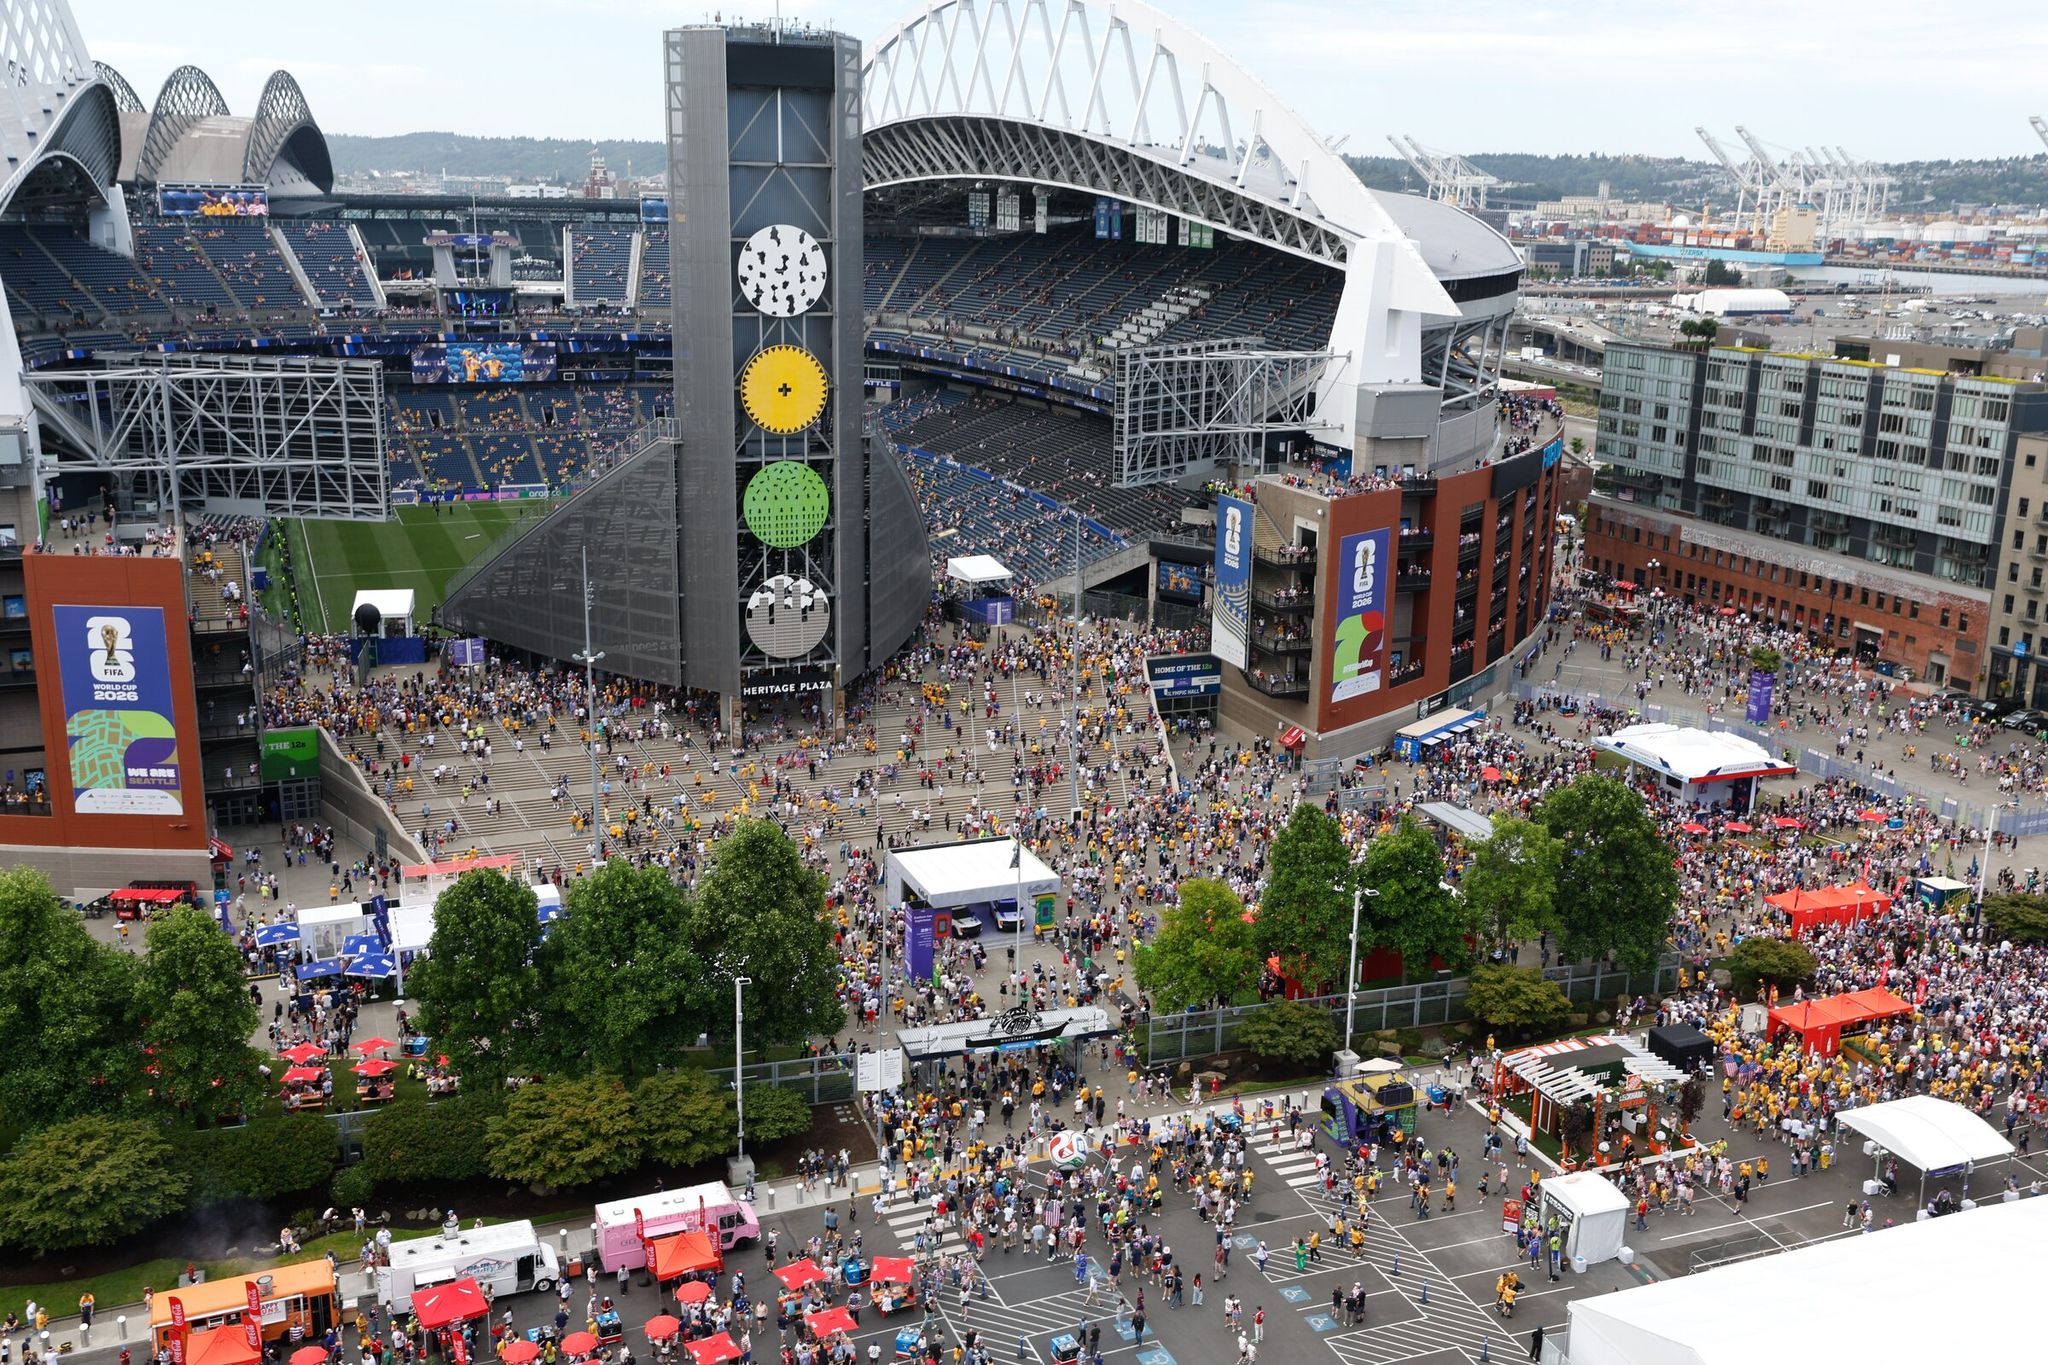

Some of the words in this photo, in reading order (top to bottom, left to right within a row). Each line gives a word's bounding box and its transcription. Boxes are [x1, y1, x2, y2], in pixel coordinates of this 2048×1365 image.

[1224, 557, 1240, 569] 2026
[1352, 597, 1373, 609] 2026
[104, 668, 124, 677] FIFA
[1155, 666, 1176, 674] HOME
[1187, 664, 1202, 672] THE
[93, 683, 121, 691] WORLD
[743, 683, 796, 696] HERITAGE
[800, 680, 833, 691] PLAZA
[94, 691, 139, 701] 2026
[271, 741, 290, 750] THE
[127, 768, 149, 777] WE
[149, 768, 176, 778] ARE
[129, 777, 177, 785] SEATTLE
[1588, 1071, 1611, 1081] EATTLE
